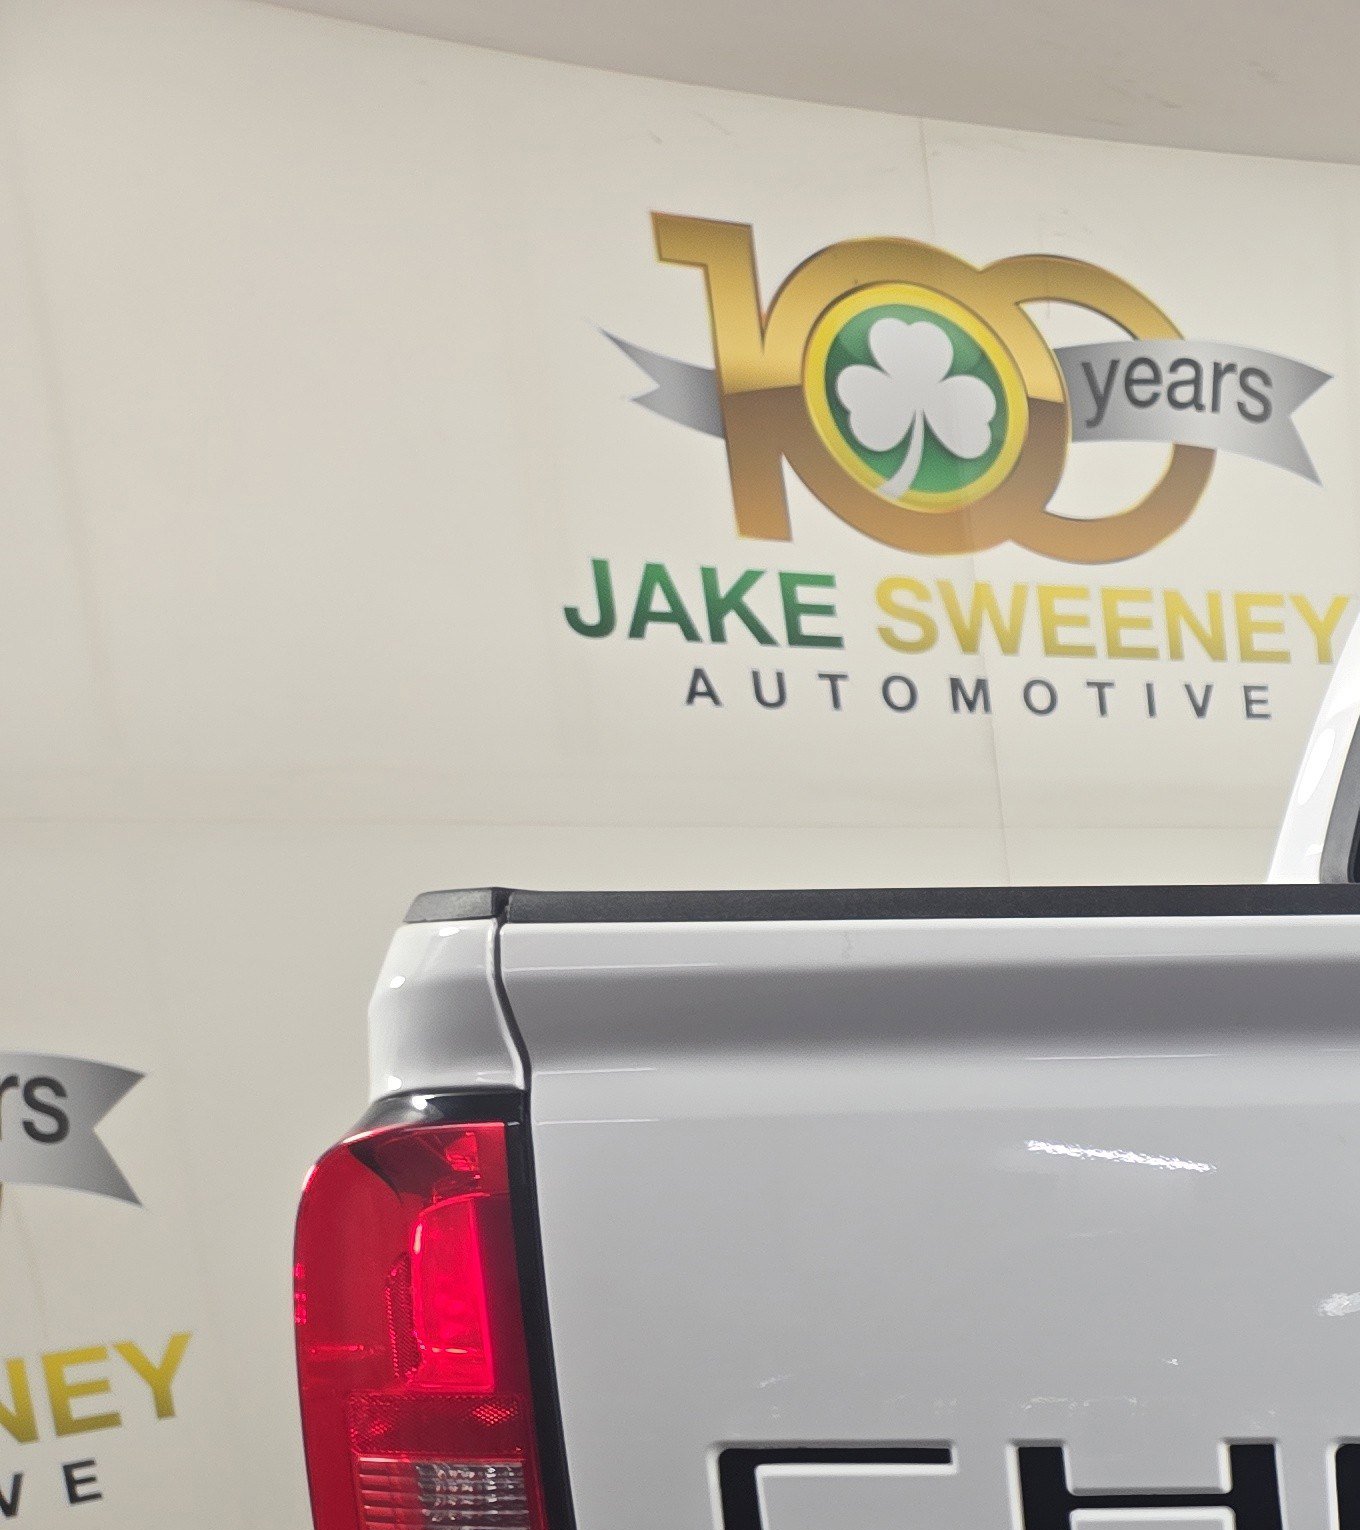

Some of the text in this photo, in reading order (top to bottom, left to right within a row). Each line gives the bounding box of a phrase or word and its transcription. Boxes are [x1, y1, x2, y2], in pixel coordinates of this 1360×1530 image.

[651, 210, 1218, 566] 100
[1081, 356, 1274, 427] years
[563, 557, 1350, 664] JAKE SWEENEY
[684, 667, 1272, 720] AUTOMOTIVE
